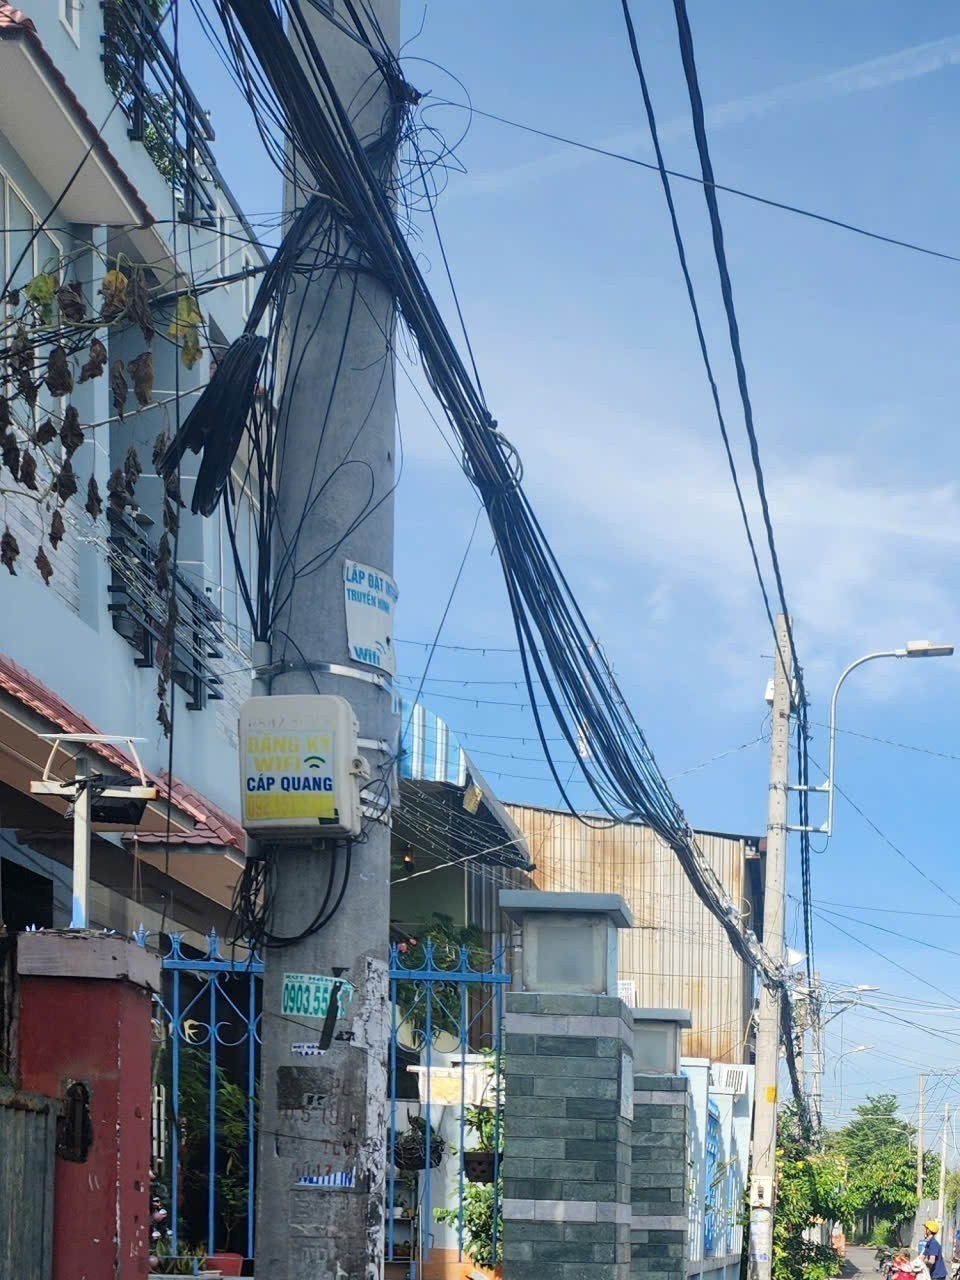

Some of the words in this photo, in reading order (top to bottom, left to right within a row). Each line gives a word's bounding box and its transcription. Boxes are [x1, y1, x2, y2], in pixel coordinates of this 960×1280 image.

[246, 773, 275, 792] CÁP
[280, 777, 333, 793] QUANG
[283, 983, 333, 1017] 0903.55
